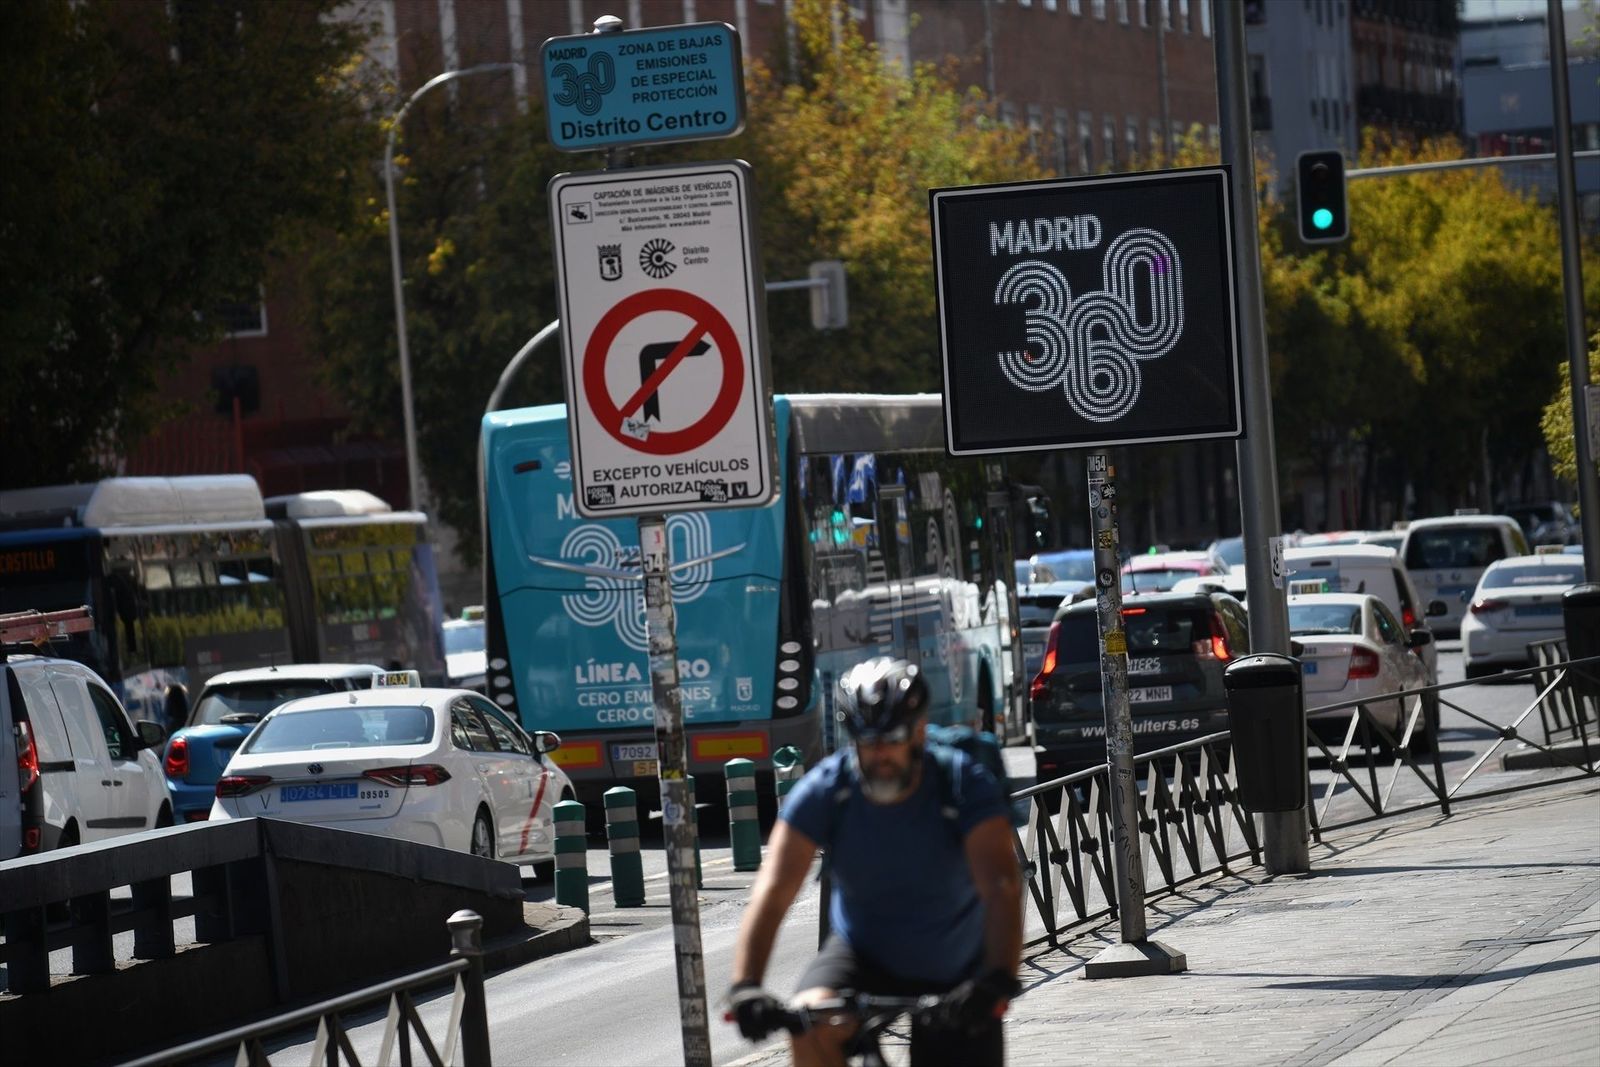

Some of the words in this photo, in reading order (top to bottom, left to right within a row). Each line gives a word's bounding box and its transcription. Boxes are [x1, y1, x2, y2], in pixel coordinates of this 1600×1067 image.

[549, 47, 587, 61] MADRID
[618, 42, 654, 56] ZONA
[657, 40, 677, 52] DE
[679, 35, 722, 50] BAJAS
[636, 53, 708, 71] EMISIONES
[551, 51, 616, 116] 360
[631, 75, 649, 88] DE
[652, 69, 716, 85] ESPECIAL
[632, 84, 718, 104] PROTECCIÓN
[561, 116, 640, 140] Distrito
[647, 109, 727, 132] Centro
[593, 189, 632, 200] CAPTACIÓN
[633, 188, 642, 197] DE
[645, 184, 680, 195] IMÁGENES
[681, 184, 691, 192] DE
[694, 180, 733, 191] VEHÍCULOS
[988, 213, 1103, 257] MADRID
[682, 245, 710, 256] Distrito
[683, 256, 709, 266] Centro
[993, 226, 1186, 424] 360
[593, 464, 662, 482] EXCEPTO
[665, 457, 750, 476] VEHÍCULOS
[388, 673, 408, 685] TAXI
[575, 657, 642, 684] LÍNEA
[577, 691, 621, 707] CERO
[624, 686, 712, 704] EMINES
[1145, 687, 1171, 700] MNH
[597, 707, 640, 723] CERO
[620, 745, 652, 760] 7092
